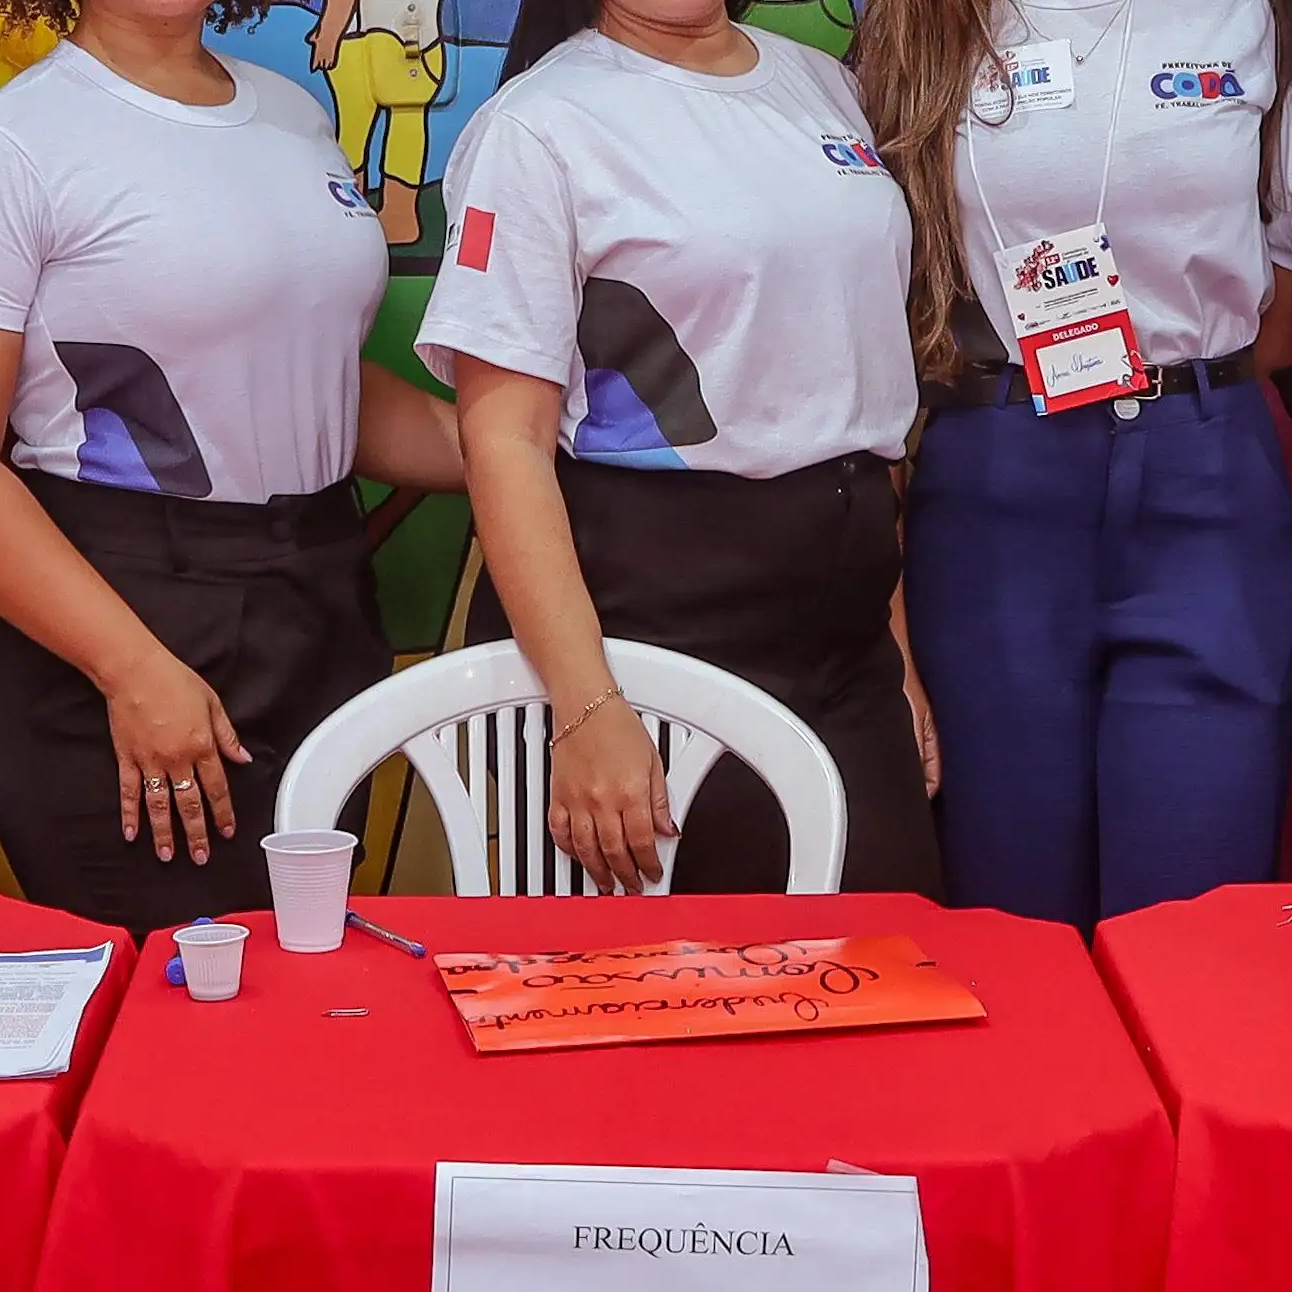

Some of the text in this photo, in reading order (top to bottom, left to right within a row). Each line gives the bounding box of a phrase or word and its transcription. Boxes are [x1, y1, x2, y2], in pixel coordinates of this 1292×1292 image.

[1043, 256, 1099, 290] SAÚDE
[1052, 323, 1099, 342] DELEGADO
[522, 960, 880, 994] Comissão
[573, 1221, 796, 1259] FREQUÊNCIA
